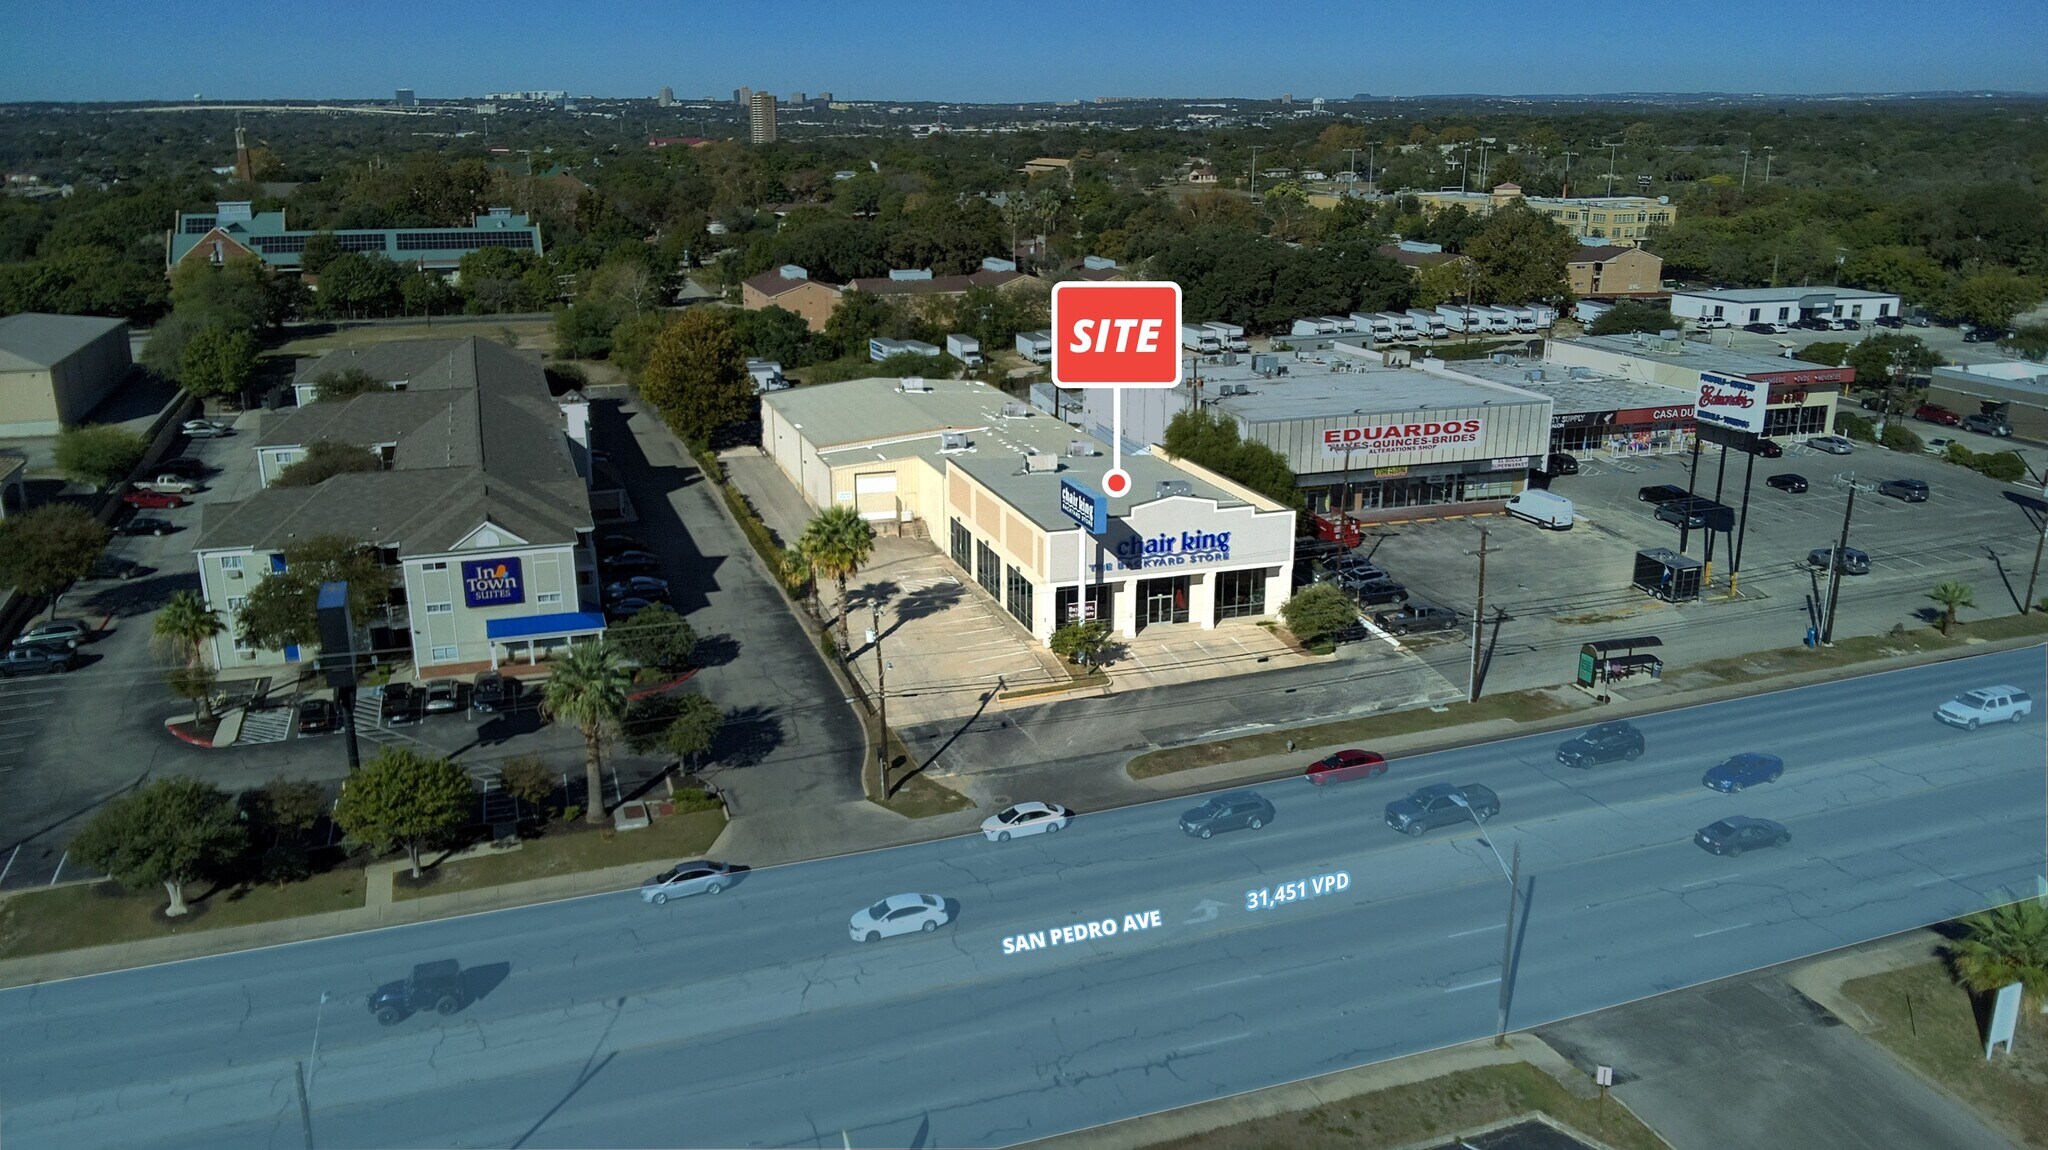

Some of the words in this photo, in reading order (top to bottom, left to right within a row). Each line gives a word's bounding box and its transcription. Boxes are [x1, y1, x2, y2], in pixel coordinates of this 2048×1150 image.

[1561, 414, 1586, 424] SUPPLY
[1653, 409, 1679, 419] CASA
[1324, 420, 1480, 443] EDUARDOS
[1368, 446, 1417, 455] ALTERATIONS
[1417, 444, 1438, 452] SHOP
[1062, 487, 1079, 508] chair
[1079, 495, 1094, 522] king
[1116, 532, 1177, 556] chair
[1181, 529, 1231, 553] king
[1117, 556, 1186, 571] BACKYARD
[1189, 552, 1230, 564] STORE
[476, 566, 495, 580] In
[467, 577, 517, 593] Town
[476, 589, 511, 600] SUITES
